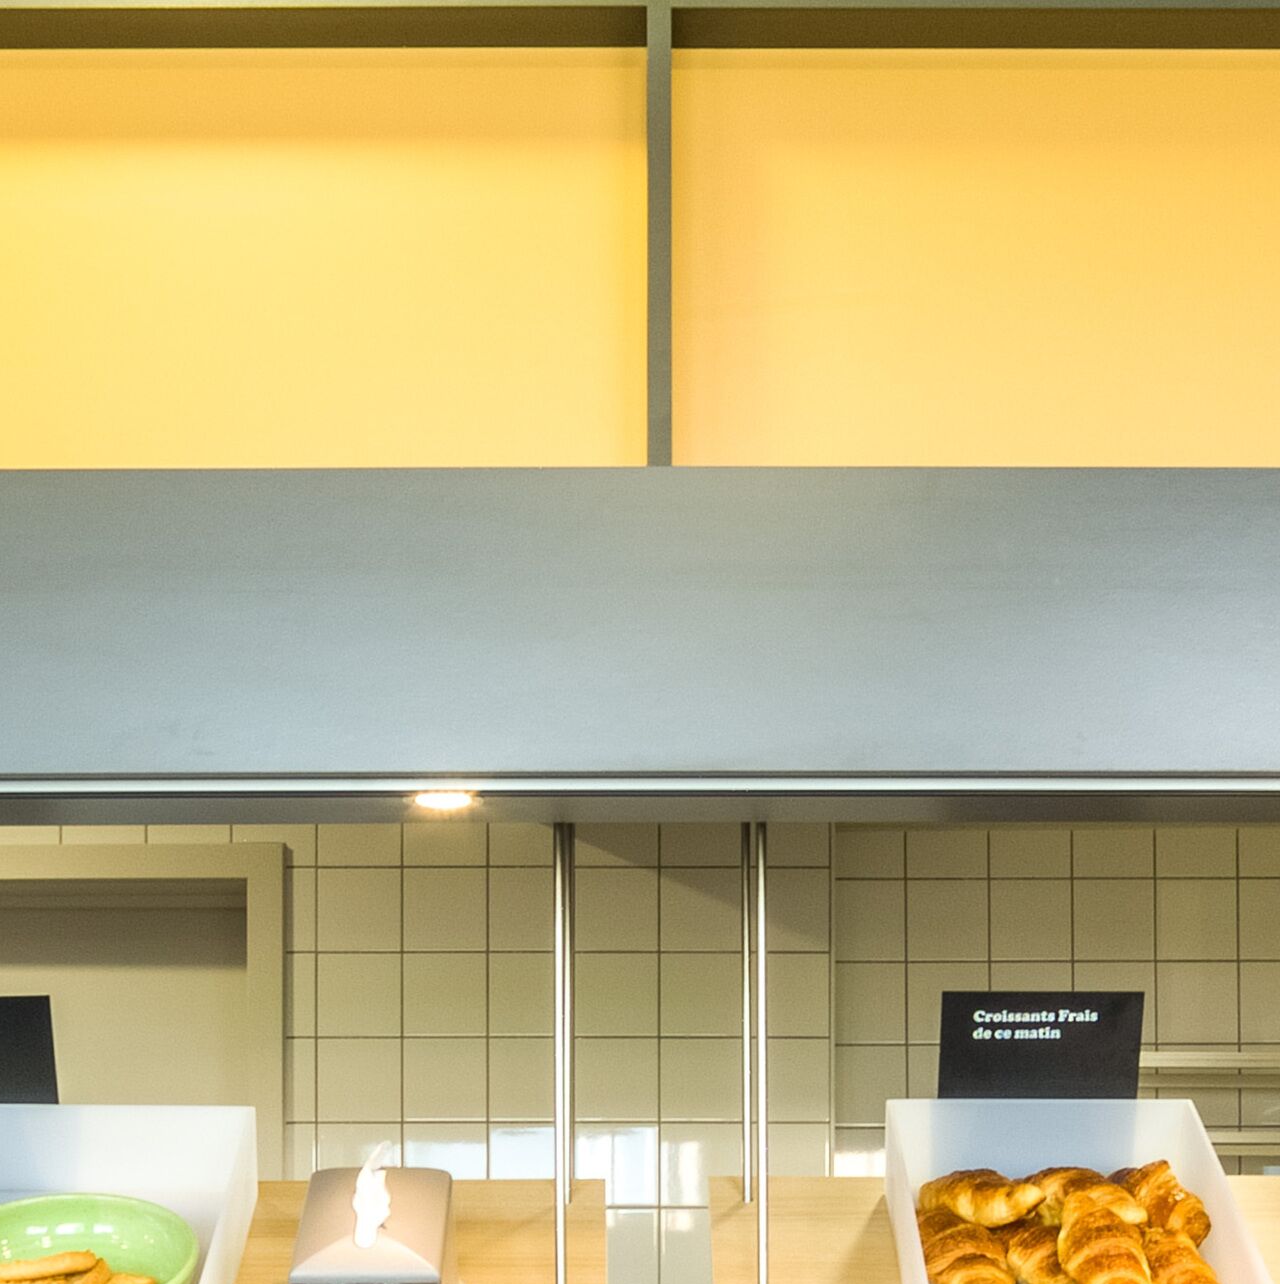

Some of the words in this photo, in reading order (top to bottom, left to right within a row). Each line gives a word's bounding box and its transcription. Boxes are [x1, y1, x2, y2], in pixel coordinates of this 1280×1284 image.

[973, 1010, 1056, 1023] Croissants
[1058, 1009, 1098, 1022] Frais
[972, 1027, 992, 1039] de
[994, 1029, 1012, 1039] ce
[1014, 1026, 1061, 1039] matin
